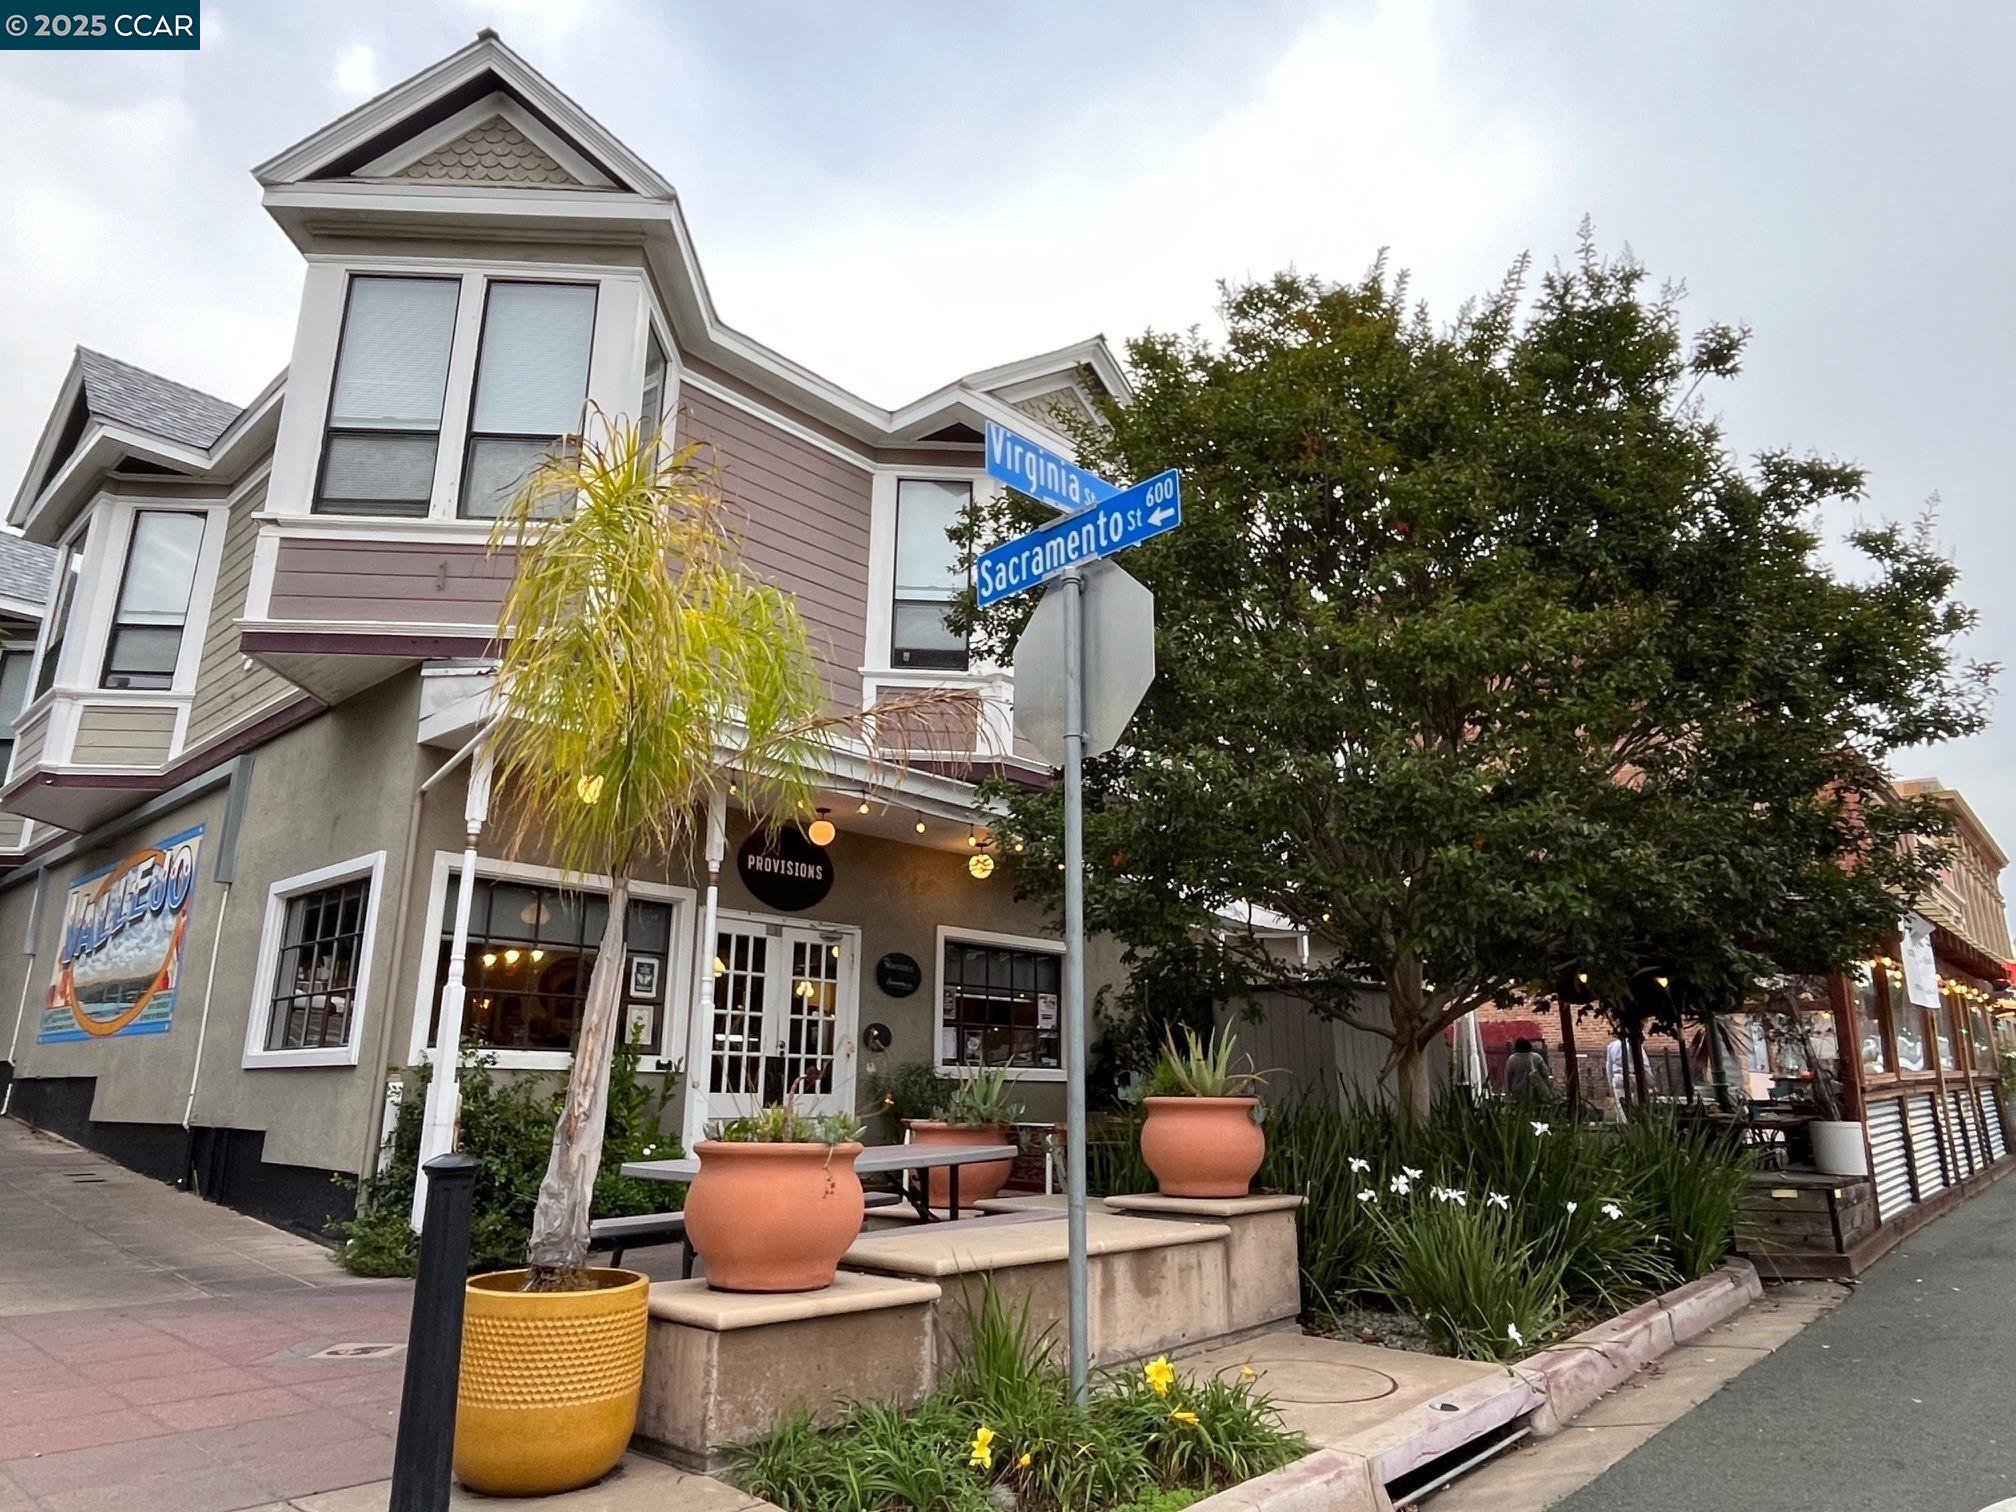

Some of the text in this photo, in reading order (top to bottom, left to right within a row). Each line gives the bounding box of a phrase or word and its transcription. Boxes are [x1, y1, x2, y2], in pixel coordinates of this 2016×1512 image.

[990, 423, 1096, 506] Virginia St
[1145, 478, 1173, 507] 600
[980, 507, 1142, 598] Sacramento St
[61, 845, 193, 967] VALLEJO
[747, 854, 823, 881] PROVISIONS
